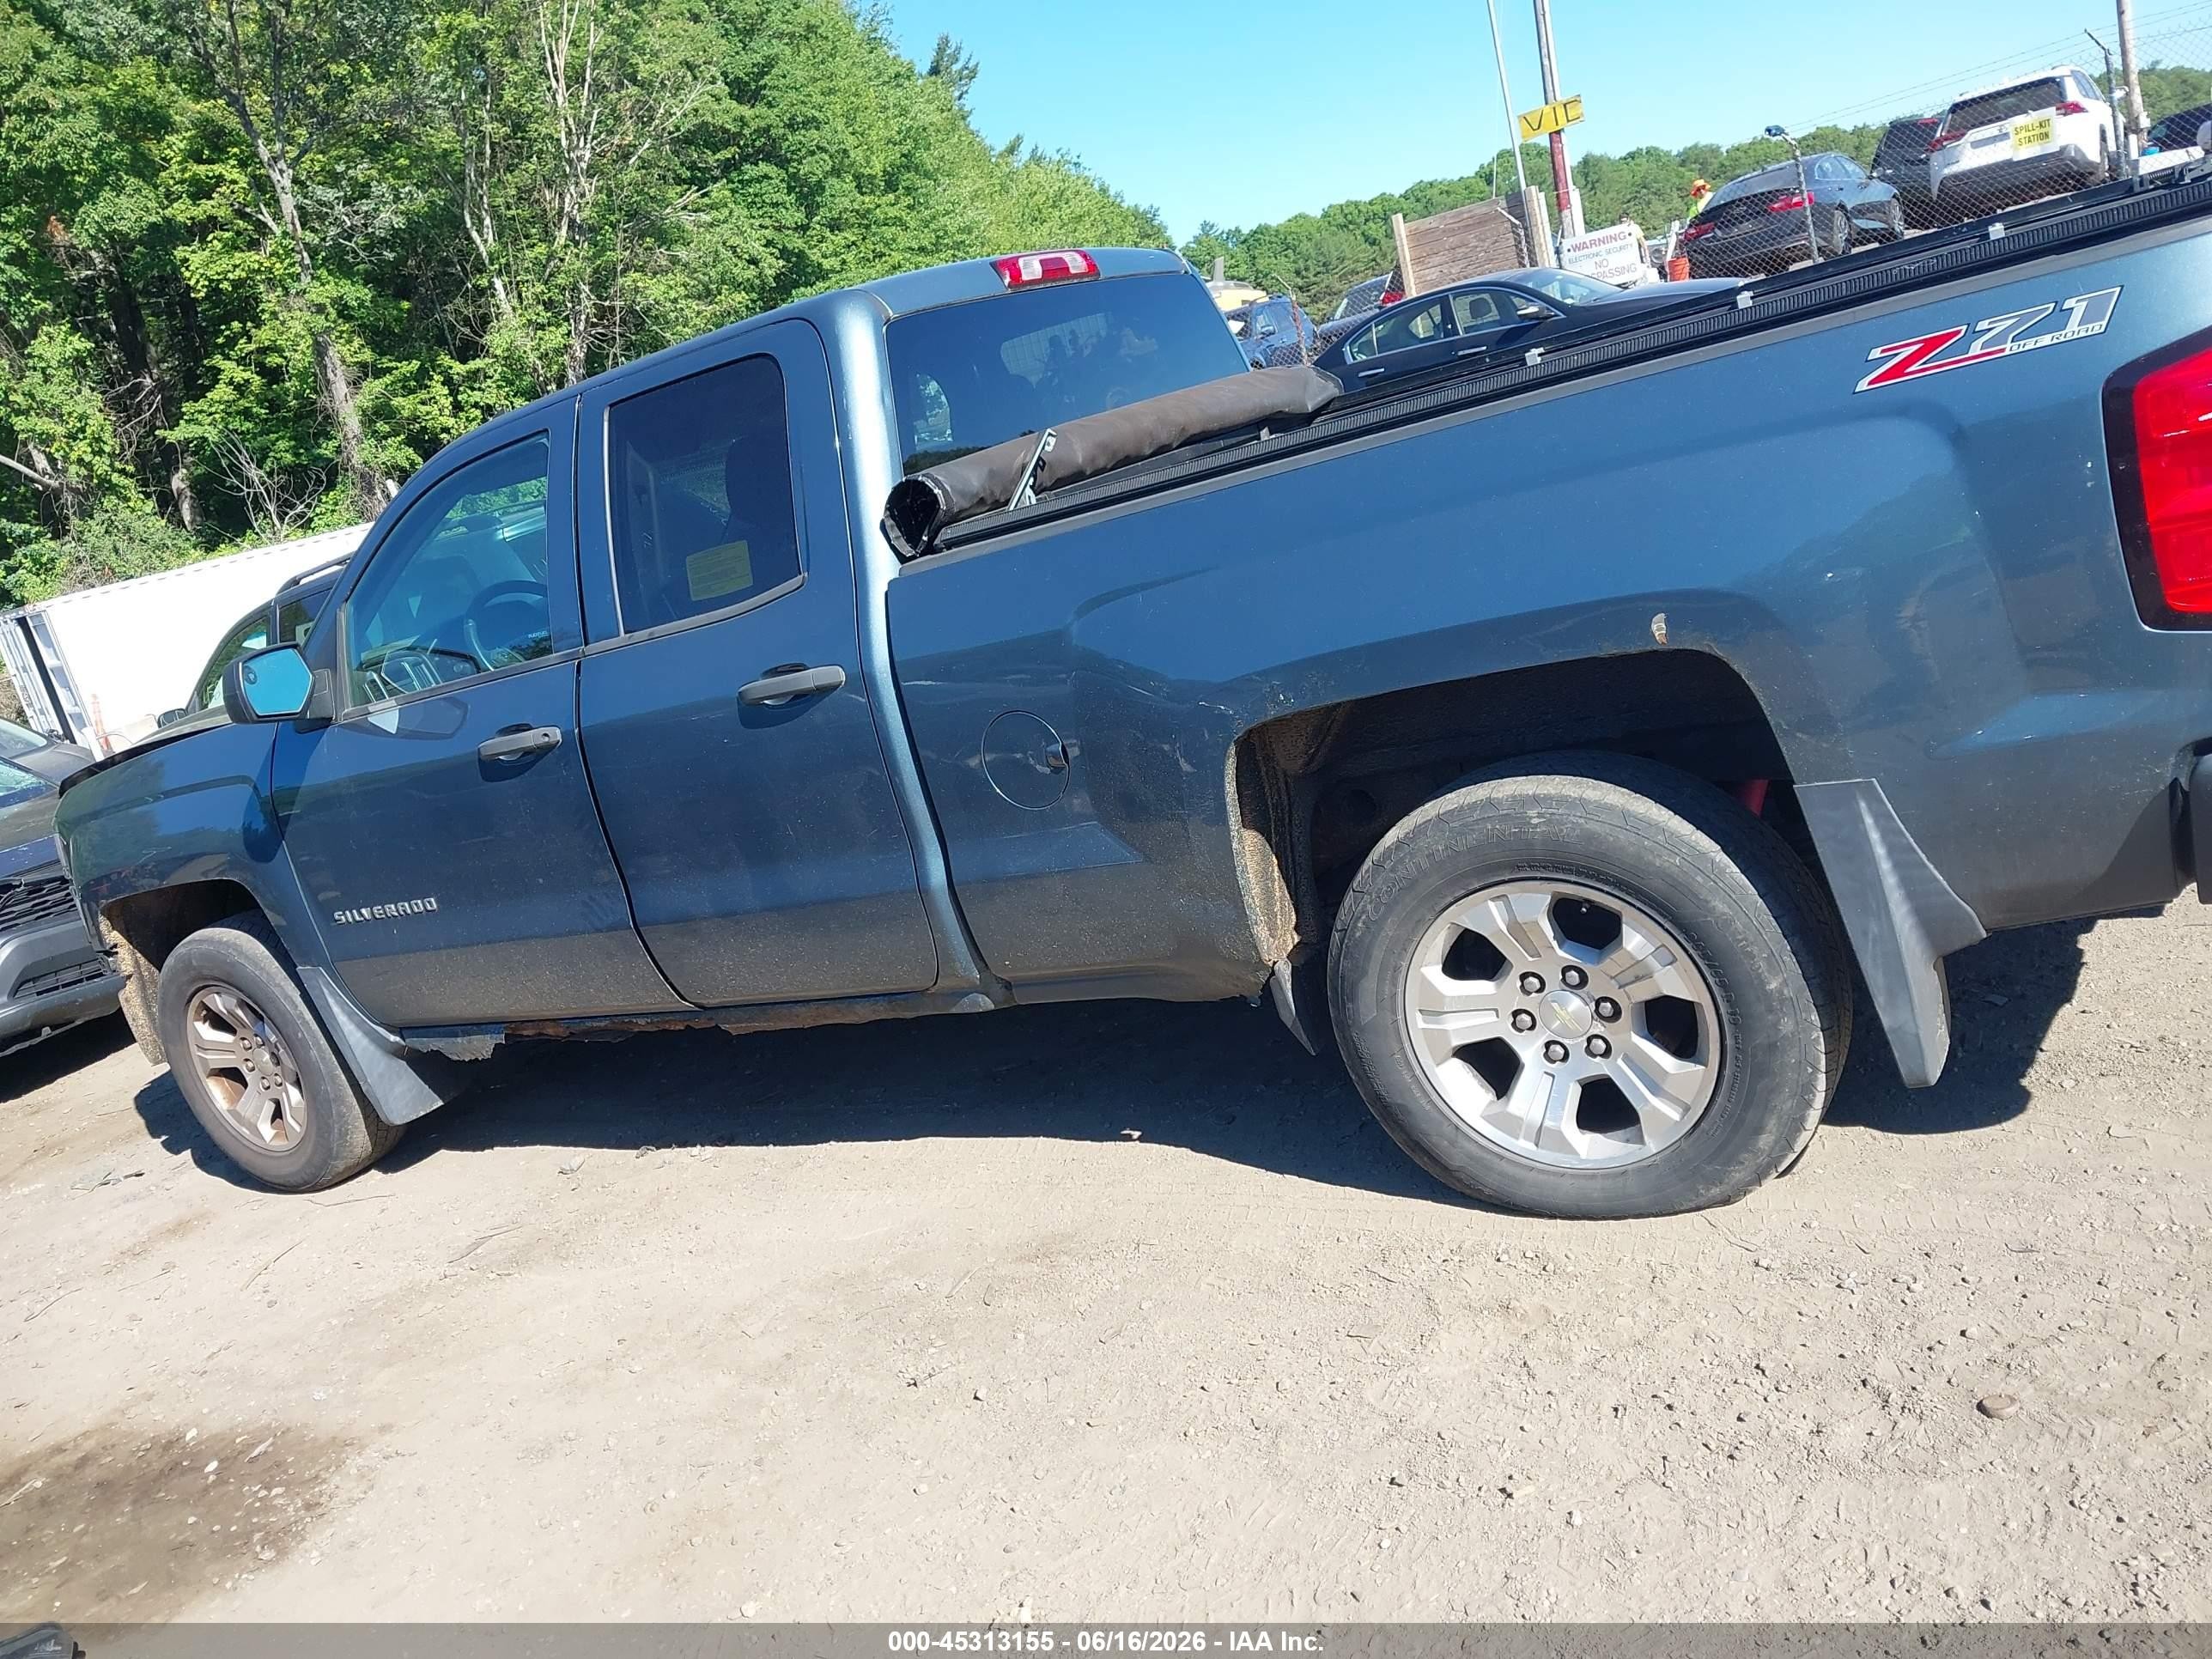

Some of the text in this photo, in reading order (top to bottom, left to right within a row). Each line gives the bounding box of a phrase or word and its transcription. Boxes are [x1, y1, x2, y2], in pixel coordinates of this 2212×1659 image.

[2014, 118, 2051, 137] SPILL-KIT
[2018, 131, 2050, 147] STATION
[1571, 231, 1627, 253] WARNING
[1569, 243, 1633, 264] ELECTRONIC SECURITY
[1595, 258, 1609, 270] NO
[1853, 284, 2124, 394] Z71
[2009, 324, 2103, 352] OFF ROAD
[333, 897, 437, 925] SILVERADO
